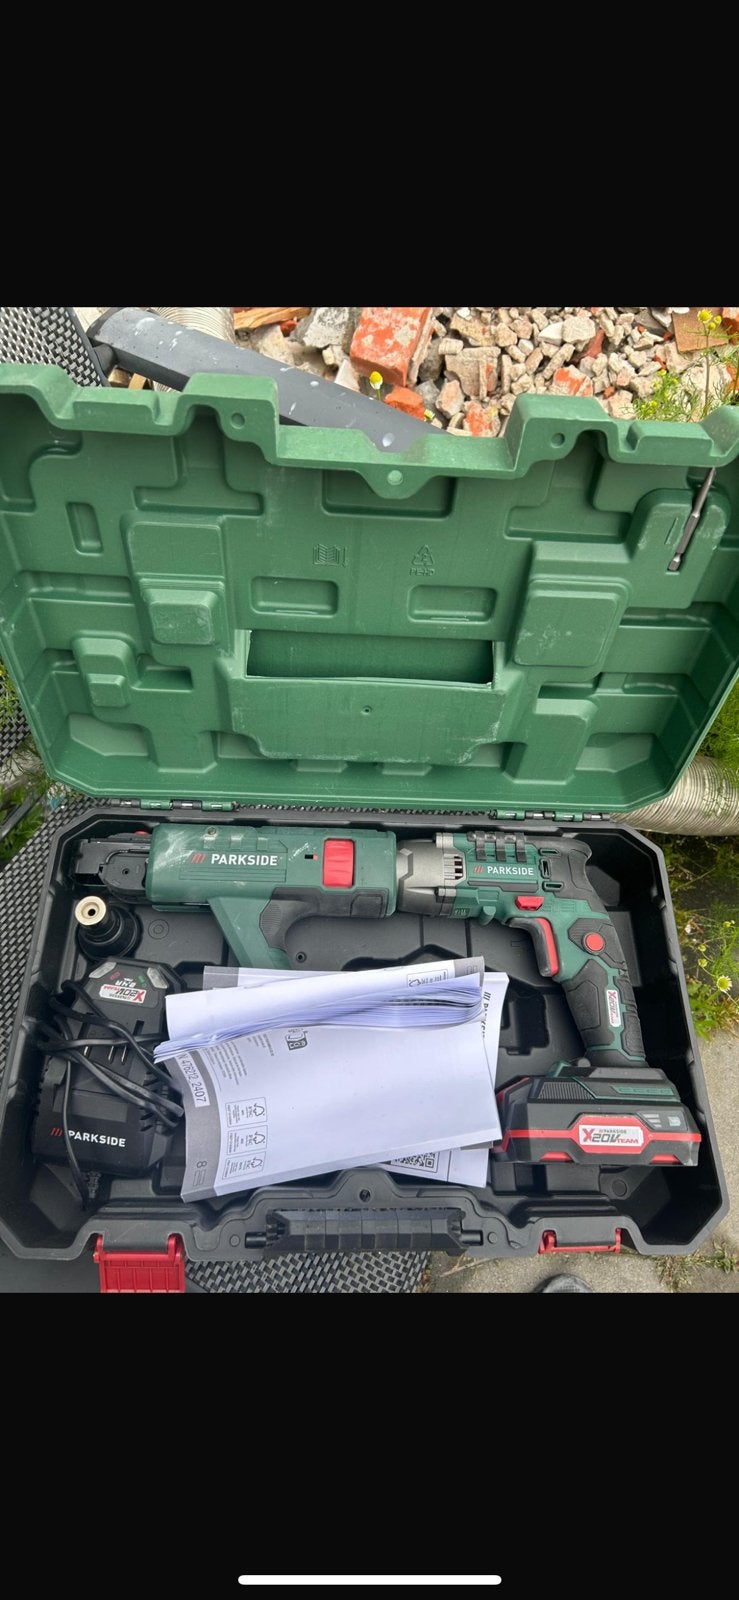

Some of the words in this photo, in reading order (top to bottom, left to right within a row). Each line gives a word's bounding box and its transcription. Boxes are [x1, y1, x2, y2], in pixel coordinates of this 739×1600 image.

[211, 853, 278, 867] PARKSIDE
[487, 866, 534, 876] PARKSIDE
[191, 1082, 207, 1103] 2407
[68, 1130, 126, 1148] PARKSIDE
